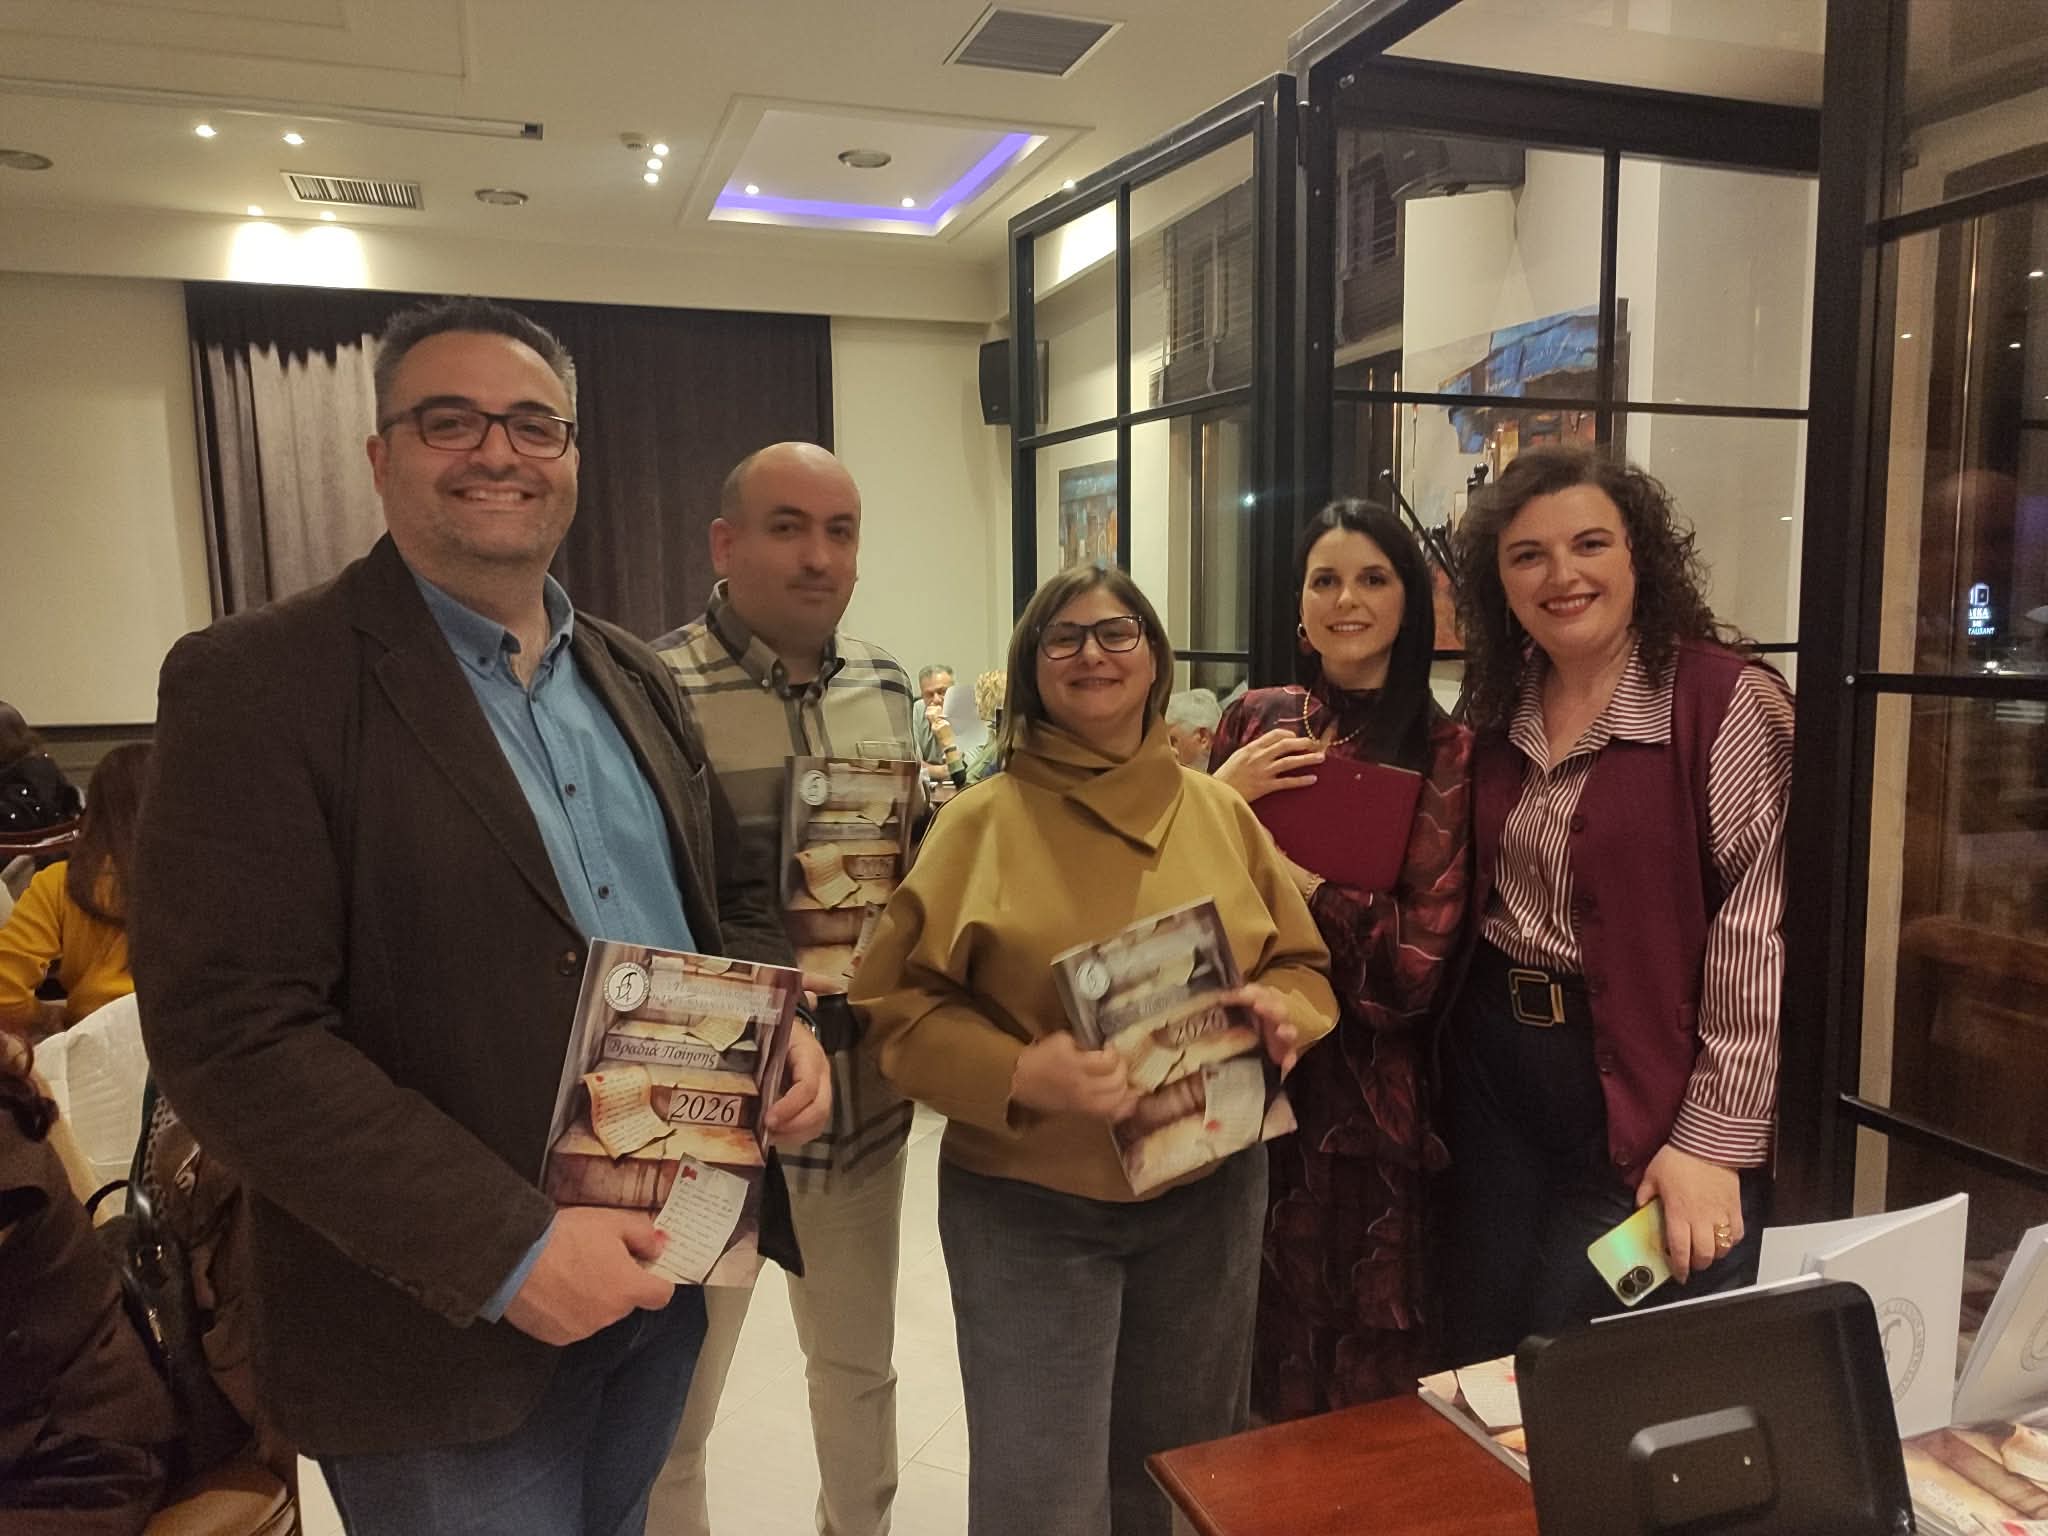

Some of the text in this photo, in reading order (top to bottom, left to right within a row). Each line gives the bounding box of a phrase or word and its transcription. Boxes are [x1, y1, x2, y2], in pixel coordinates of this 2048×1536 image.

[609, 1038, 717, 1067] Βραδιά Ποίησης
[670, 1093, 741, 1123] 2026
